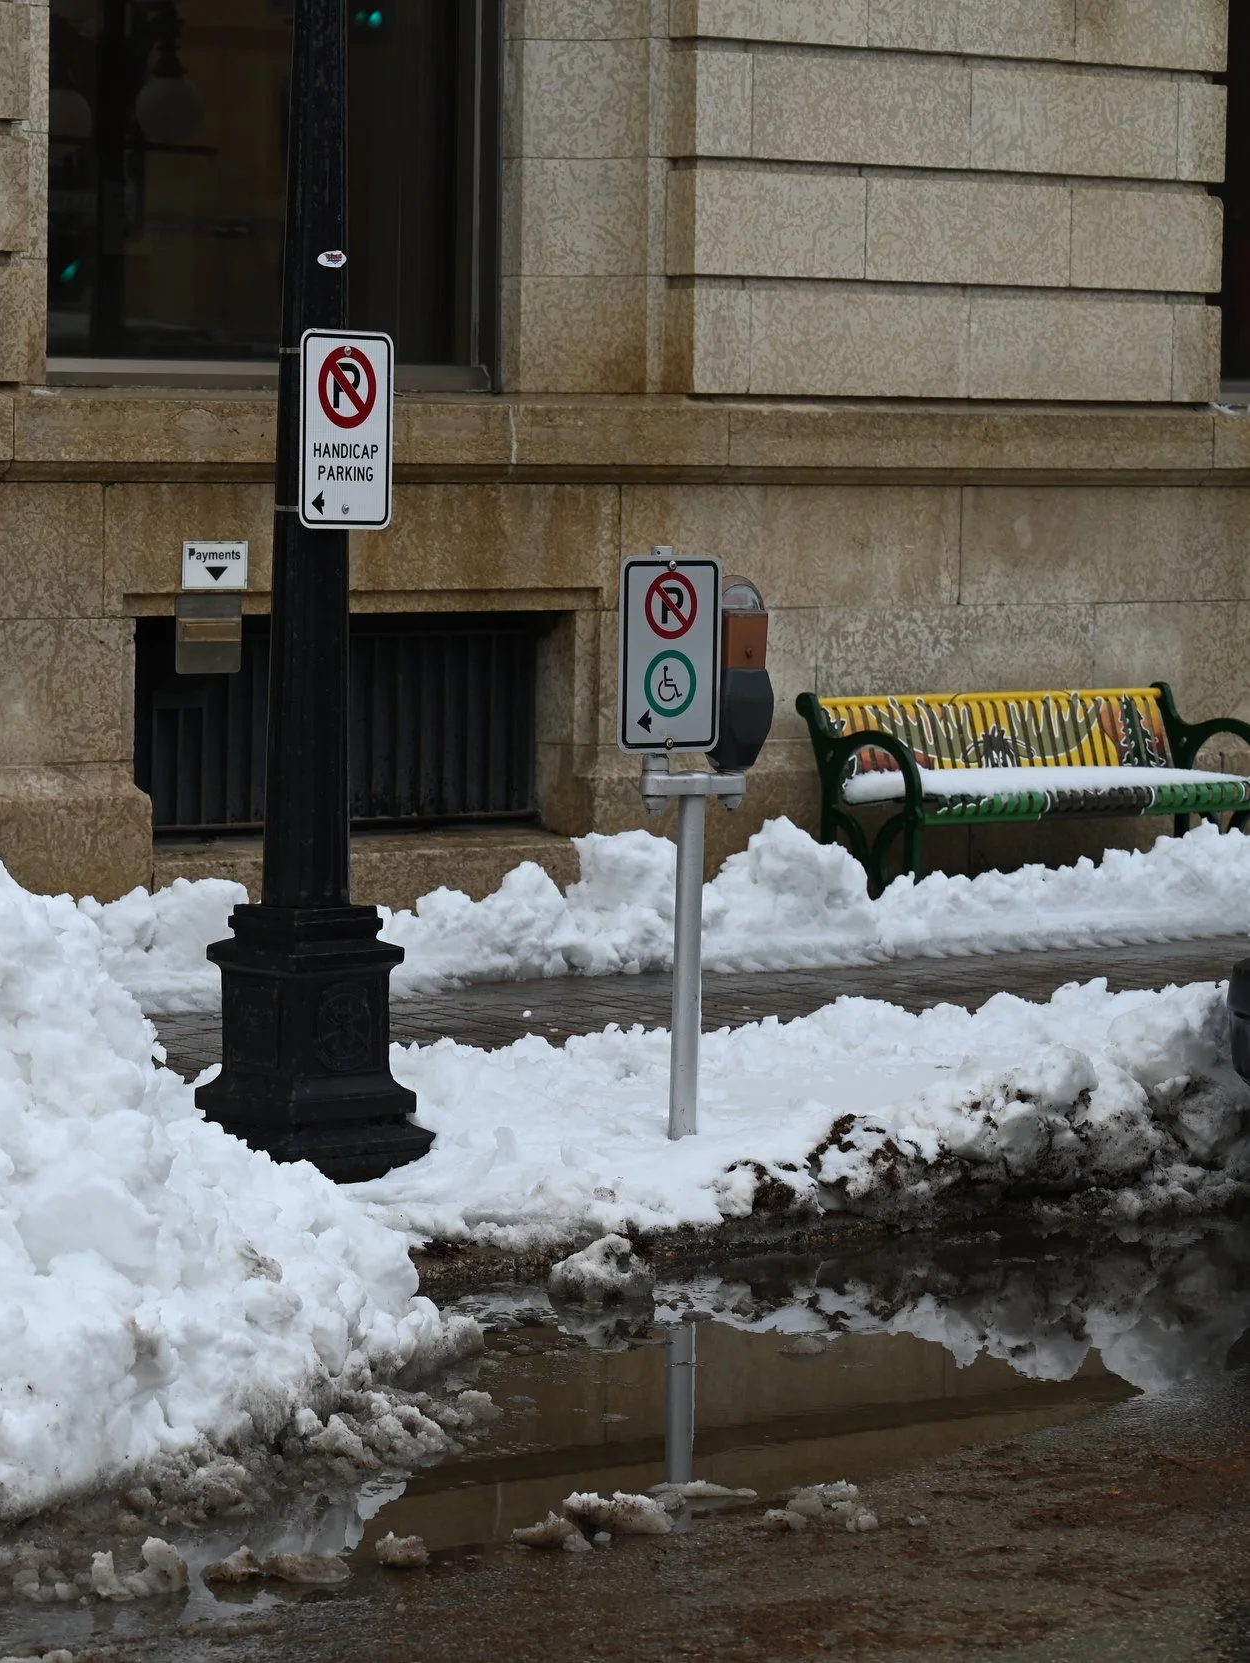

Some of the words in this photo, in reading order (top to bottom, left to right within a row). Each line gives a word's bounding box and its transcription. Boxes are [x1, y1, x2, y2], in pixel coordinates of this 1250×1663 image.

[313, 442, 379, 460] HANDICAP
[317, 465, 374, 482] PARKING
[188, 547, 241, 563] Payments
